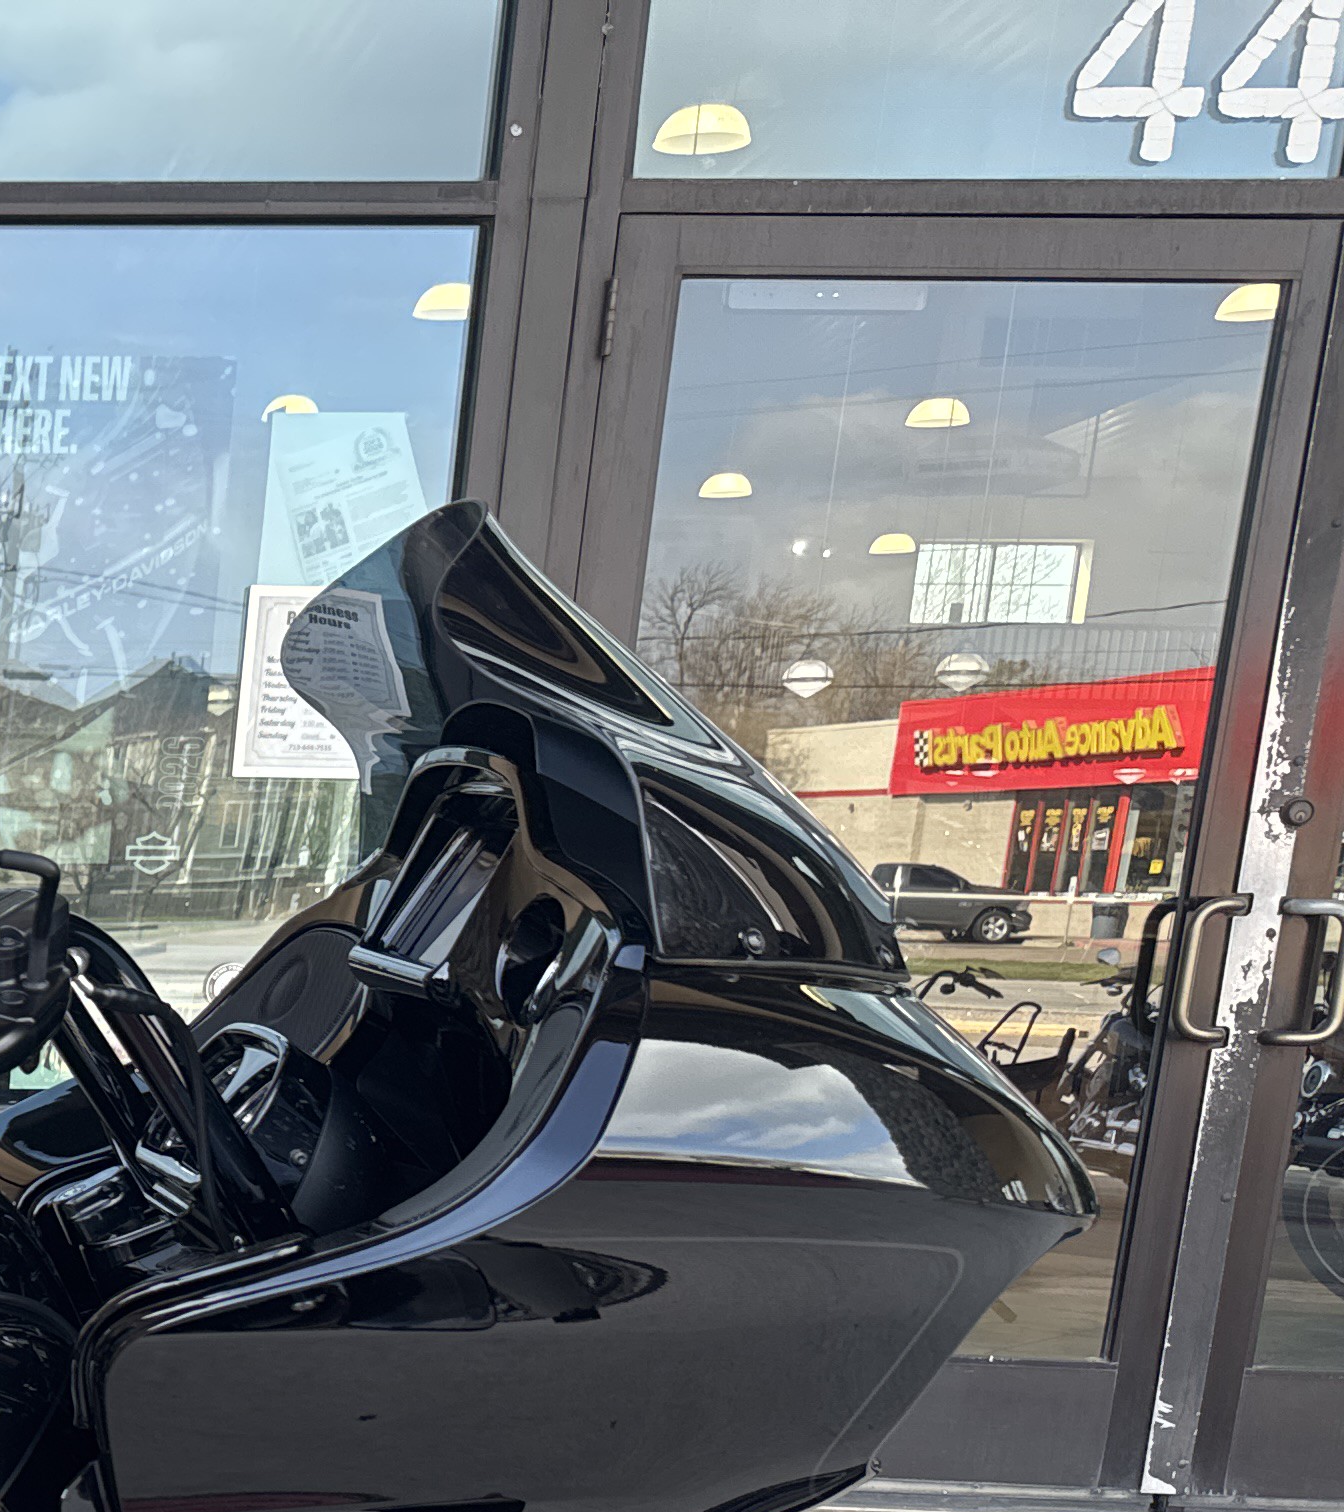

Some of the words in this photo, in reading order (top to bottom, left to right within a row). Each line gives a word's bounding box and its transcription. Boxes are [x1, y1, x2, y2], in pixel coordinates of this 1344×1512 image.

[1072, 0, 1344, 163] 44
[59, 355, 132, 401] NEW
[309, 613, 352, 630] Hours
[260, 705, 287, 716] Friday
[258, 718, 296, 729] Saturday
[257, 730, 289, 741] Sunday
